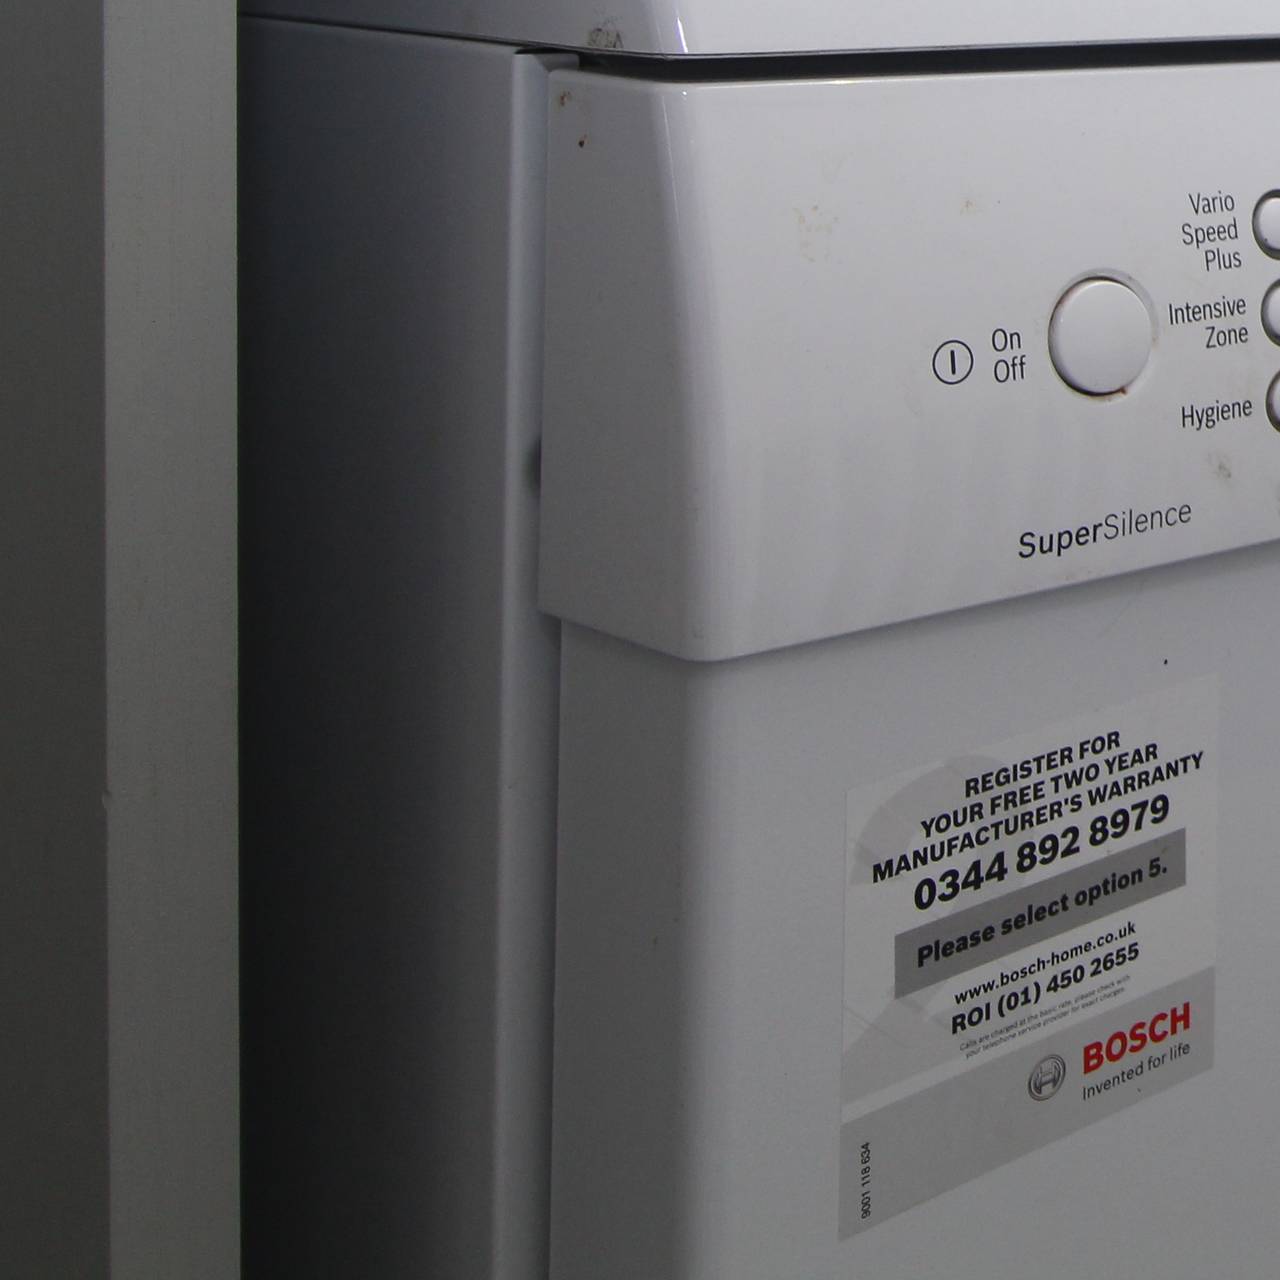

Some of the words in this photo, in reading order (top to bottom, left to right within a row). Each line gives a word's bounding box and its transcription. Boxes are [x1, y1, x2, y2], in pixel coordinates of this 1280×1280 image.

[1188, 191, 1236, 217] Vario
[1181, 217, 1239, 250] Speed
[1203, 248, 1242, 273] Plus
[1168, 295, 1247, 326] Intensive
[991, 327, 1022, 353] On
[1204, 326, 1250, 351] Zone
[993, 355, 1027, 384] Off
[1181, 396, 1254, 432] Hygiene
[1018, 501, 1193, 560] SuperSilence
[965, 742, 1074, 798] REGISTER
[1078, 730, 1121, 759] FOR
[920, 801, 984, 839] YOUR
[989, 780, 1046, 817] FREE
[1050, 763, 1100, 794] TWO
[1104, 742, 1158, 775] YEAR
[872, 793, 1083, 883] MANUFACTURER'S
[1088, 750, 1204, 807] WARRANTY
[913, 851, 1008, 911] 0344
[1015, 825, 1080, 874] 892
[1088, 793, 1170, 847] 8979
[917, 925, 995, 968] Please
[1000, 893, 1069, 937] select
[1074, 863, 1144, 908] option
[1148, 856, 1168, 878] 5.
[954, 920, 1136, 1005] www.bosch-home.co.uk
[951, 1002, 991, 1035] ROI
[996, 981, 1041, 1019] (01)
[1046, 965, 1085, 994] 450
[1090, 942, 1140, 976] 2655
[1082, 1002, 1192, 1075] BOSCH
[1082, 1060, 1144, 1101] Invented
[1147, 1052, 1167, 1072] for
[1168, 1041, 1191, 1064] life
[860, 1141, 871, 1165] 634
[860, 1166, 871, 1188] 118
[860, 1190, 871, 1220] 9001
